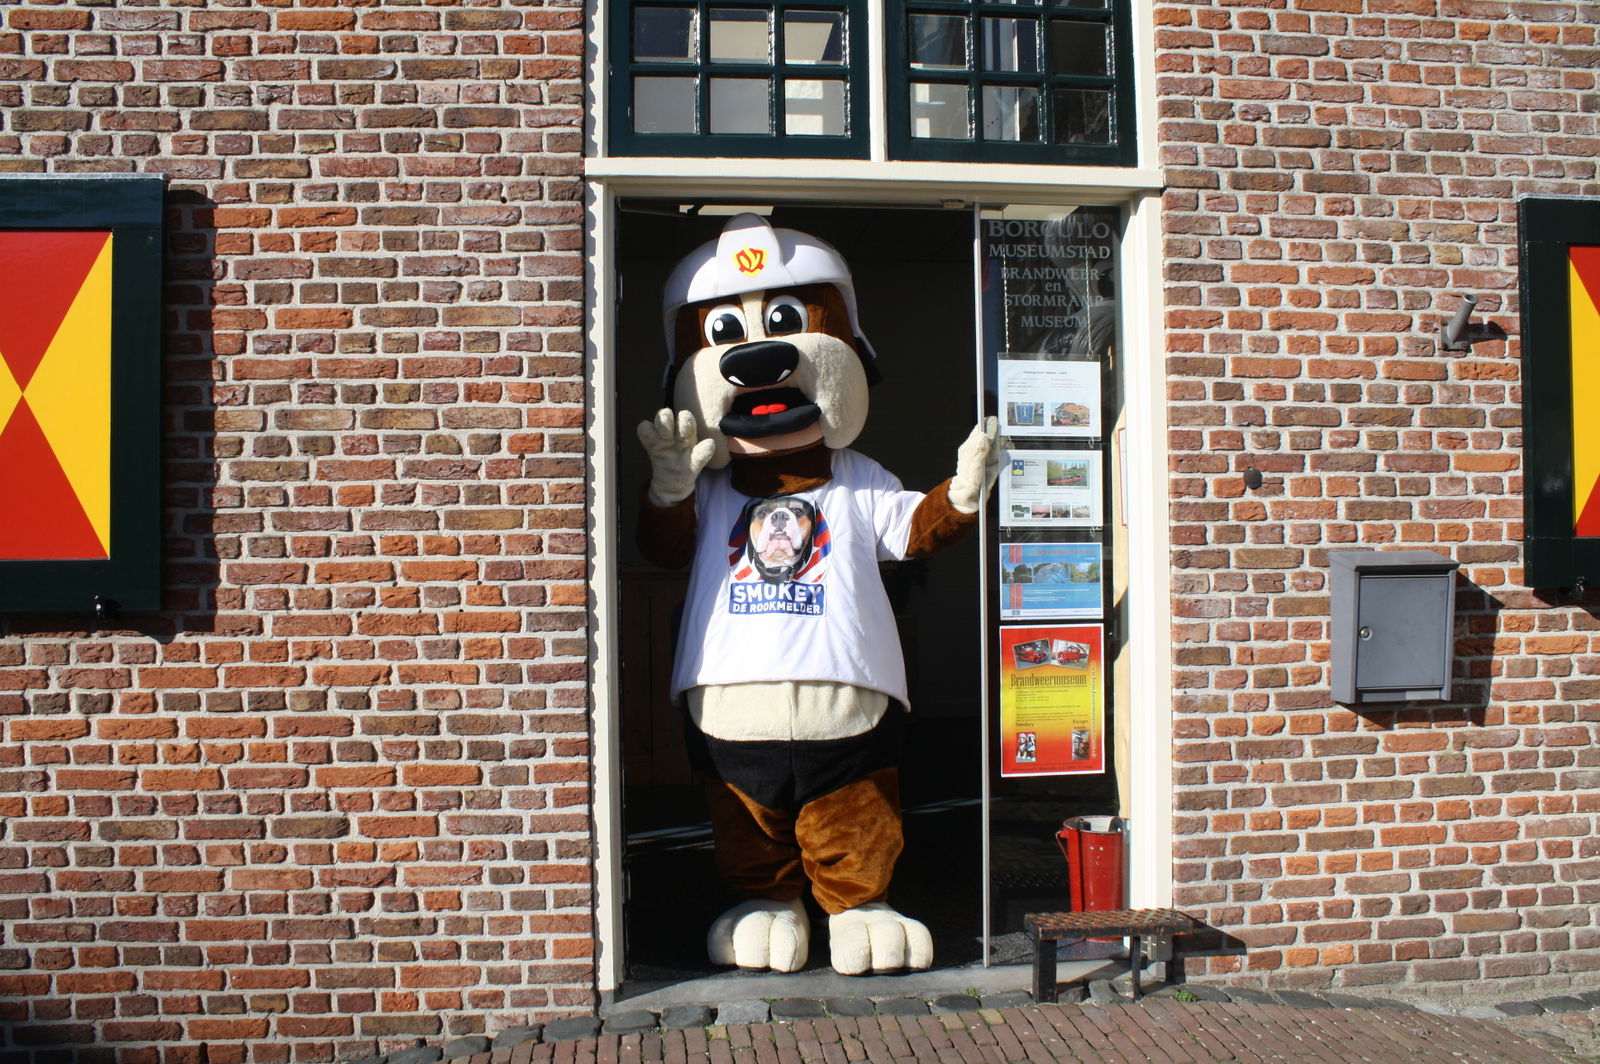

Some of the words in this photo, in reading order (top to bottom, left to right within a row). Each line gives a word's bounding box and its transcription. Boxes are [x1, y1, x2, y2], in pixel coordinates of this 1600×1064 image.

[988, 220, 1110, 240] BORCULO
[988, 244, 1111, 259] MUSEUMSTAD
[1045, 282, 1062, 293] en
[1020, 315, 1088, 328] MUSEUM
[733, 583, 822, 603] SMOKEY
[733, 603, 747, 612] DE
[749, 601, 821, 614] ROOKMELDER
[1010, 673, 1087, 687] Brandweermuseum
